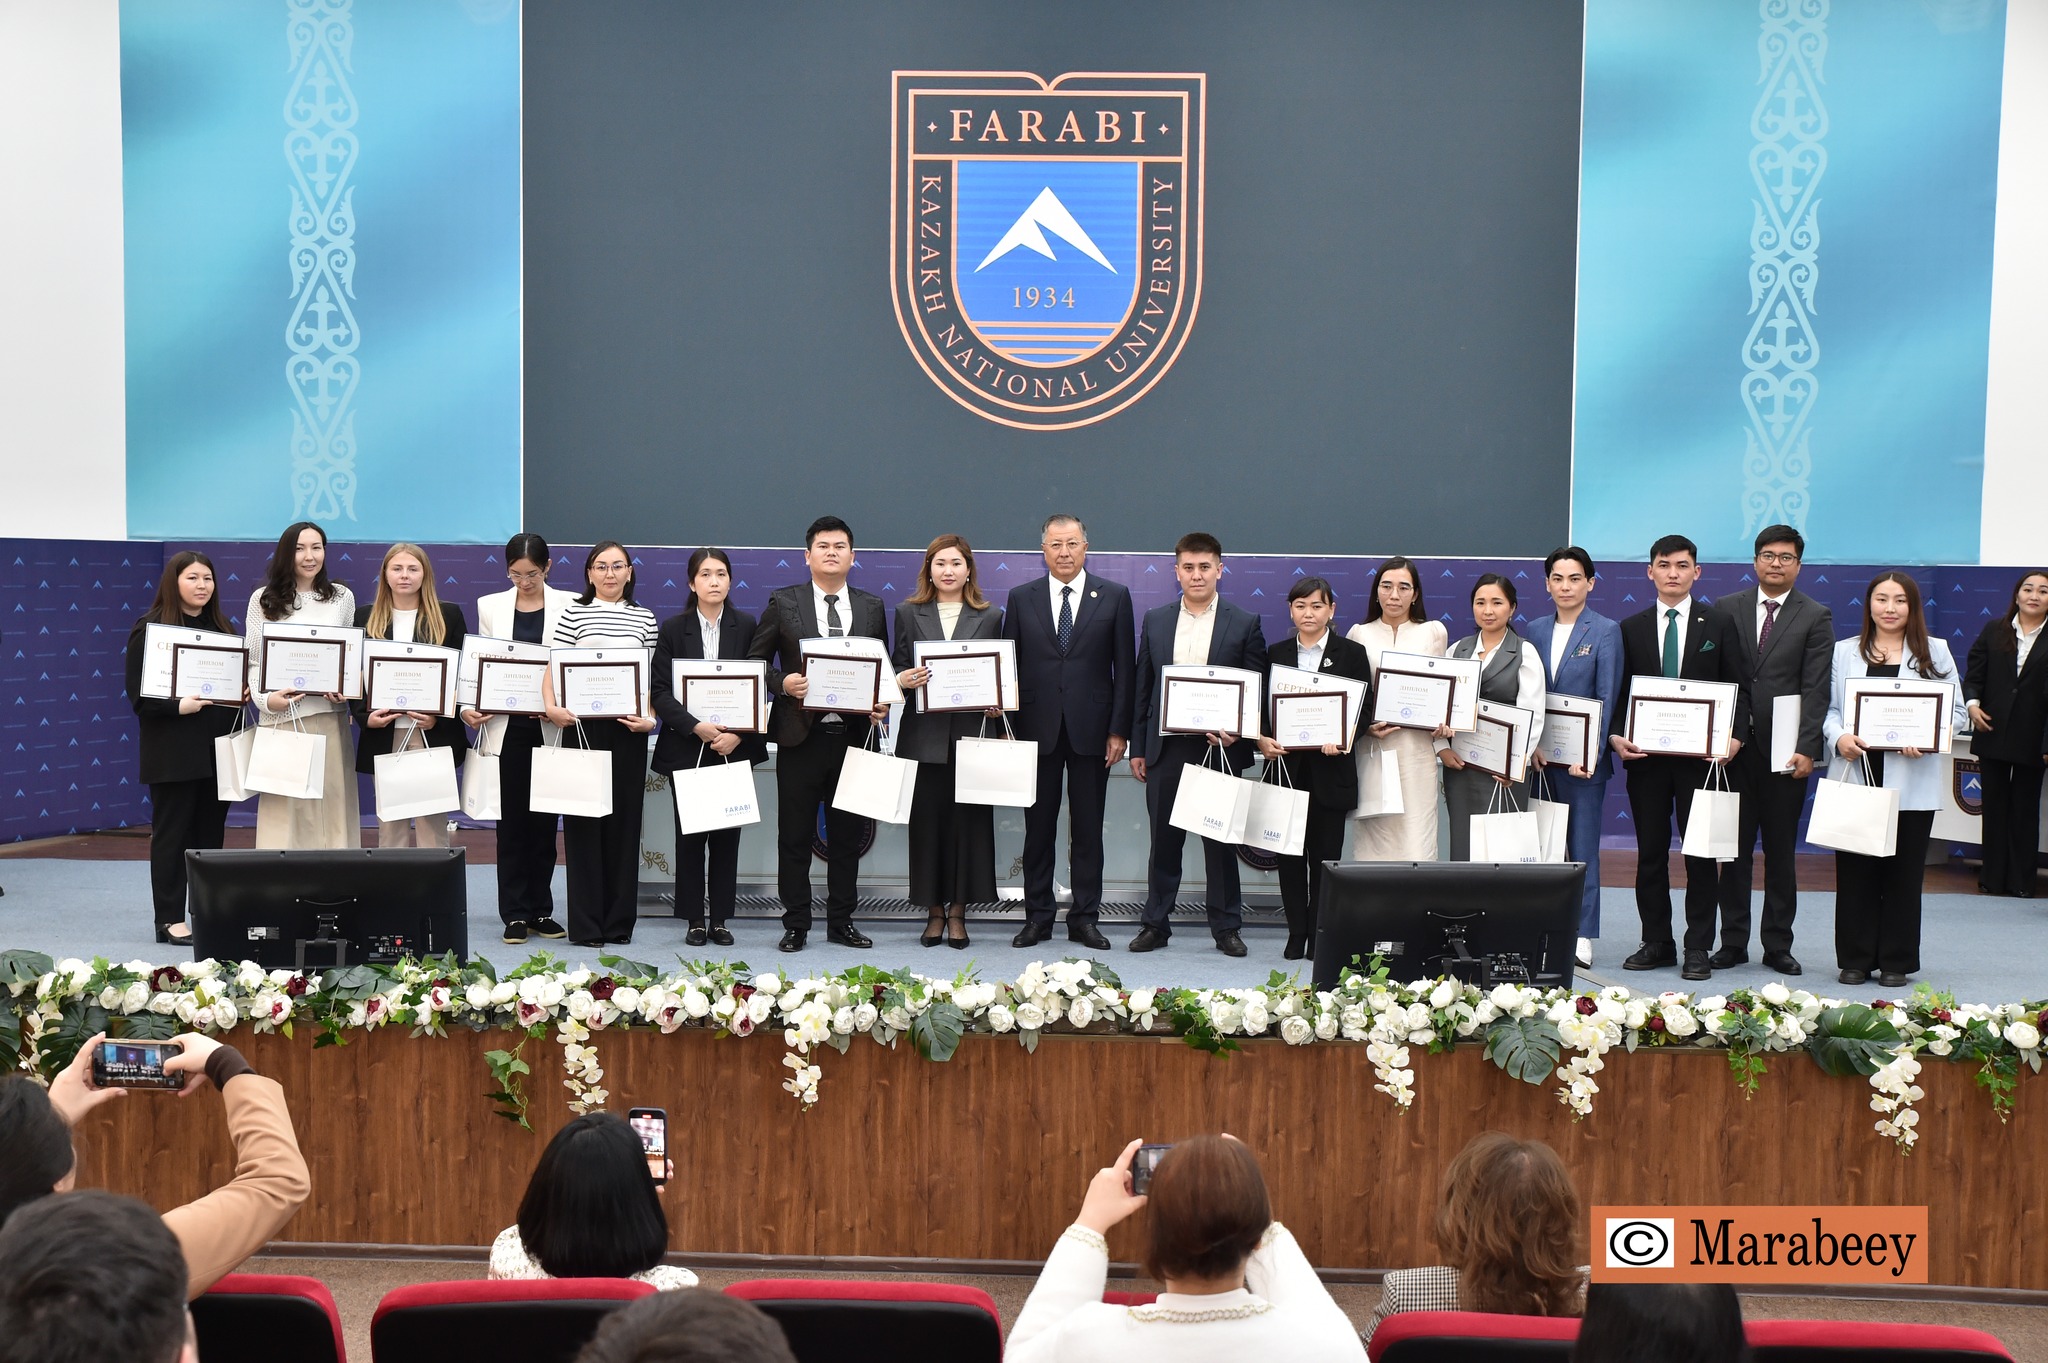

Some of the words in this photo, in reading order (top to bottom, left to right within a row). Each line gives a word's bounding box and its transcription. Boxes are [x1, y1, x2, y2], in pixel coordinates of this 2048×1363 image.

[949, 109, 1146, 143] FARABI
[921, 174, 946, 315] KAZAKH
[937, 323, 1098, 399] NATIONAL
[1105, 177, 1174, 374] UNIVERSITY
[1012, 286, 1075, 309] 1934
[725, 804, 751, 813] FARABI
[1204, 816, 1224, 828] FARABI
[1263, 829, 1281, 839] FARABI
